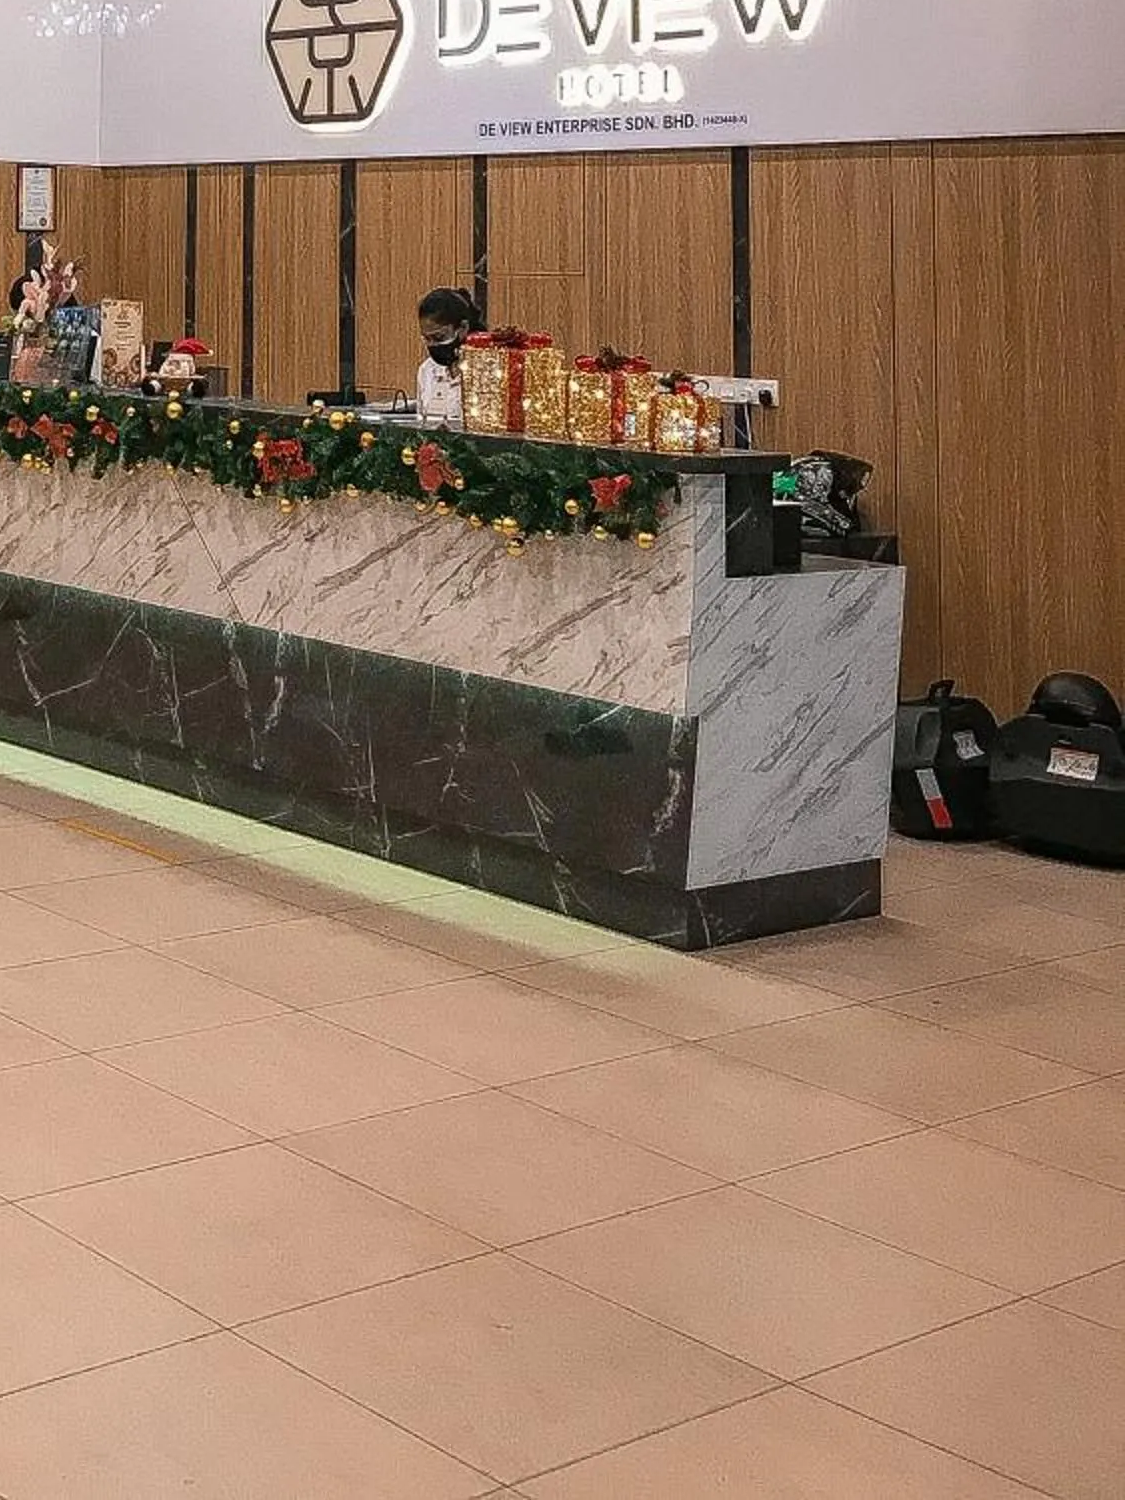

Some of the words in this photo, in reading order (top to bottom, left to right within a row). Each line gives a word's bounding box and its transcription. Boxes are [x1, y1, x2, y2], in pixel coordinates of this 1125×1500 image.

[478, 122, 496, 137] DE
[499, 120, 532, 136] VIEW
[536, 116, 621, 135] ENTERPRISE
[624, 115, 658, 131] SDN.
[662, 113, 699, 129] BHD.
